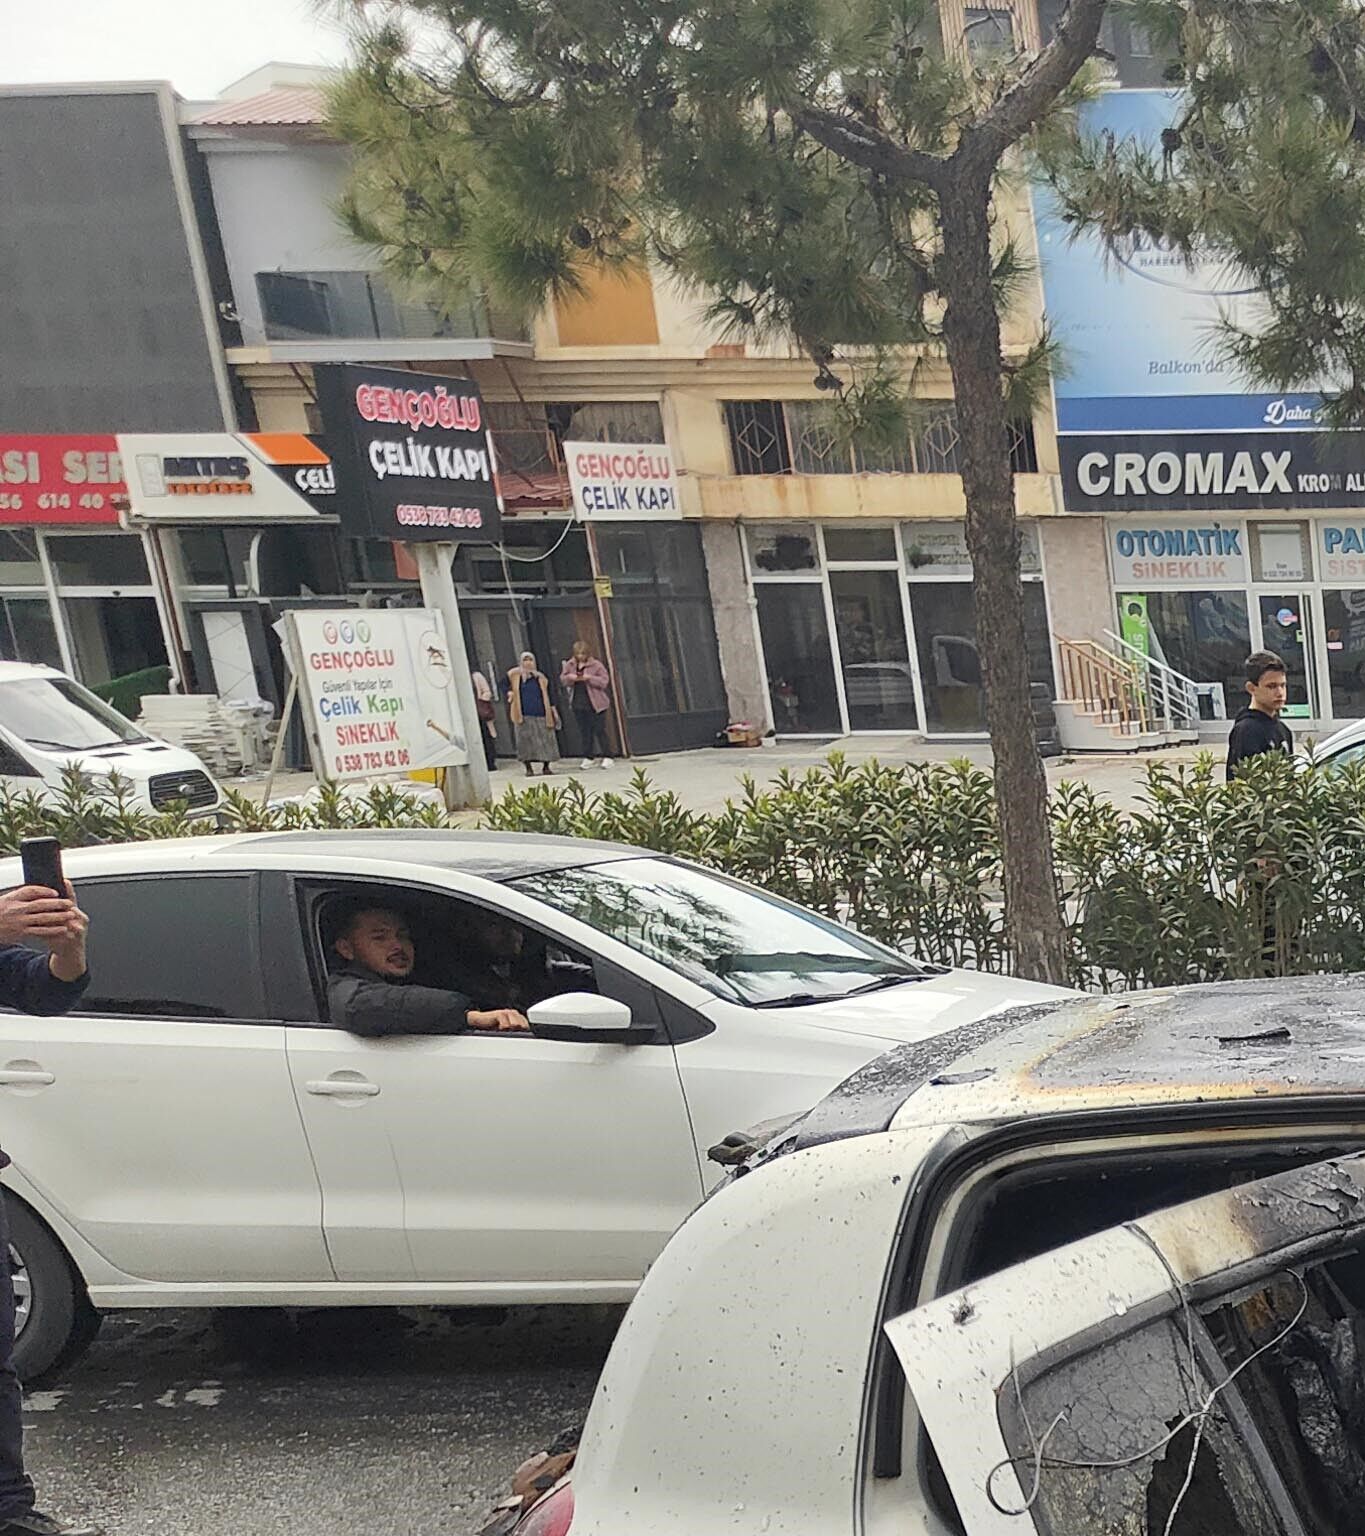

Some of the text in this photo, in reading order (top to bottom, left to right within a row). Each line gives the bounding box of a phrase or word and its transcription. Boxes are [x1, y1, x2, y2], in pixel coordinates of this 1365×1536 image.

[356, 384, 481, 431] GENÇOĞLU
[0, 450, 40, 484] SI
[369, 437, 490, 482] ÇELİK KAPI
[576, 450, 670, 481] GENÇOĞLU
[1077, 451, 1293, 496] CROMAX
[38, 493, 72, 510] 614
[79, 493, 104, 510] 40
[582, 481, 676, 515] ÇELİK KAPI
[1116, 522, 1242, 558] OTOMATİK
[310, 647, 395, 672] GENÇOĞLU
[320, 694, 404, 722] Çelik Kapı
